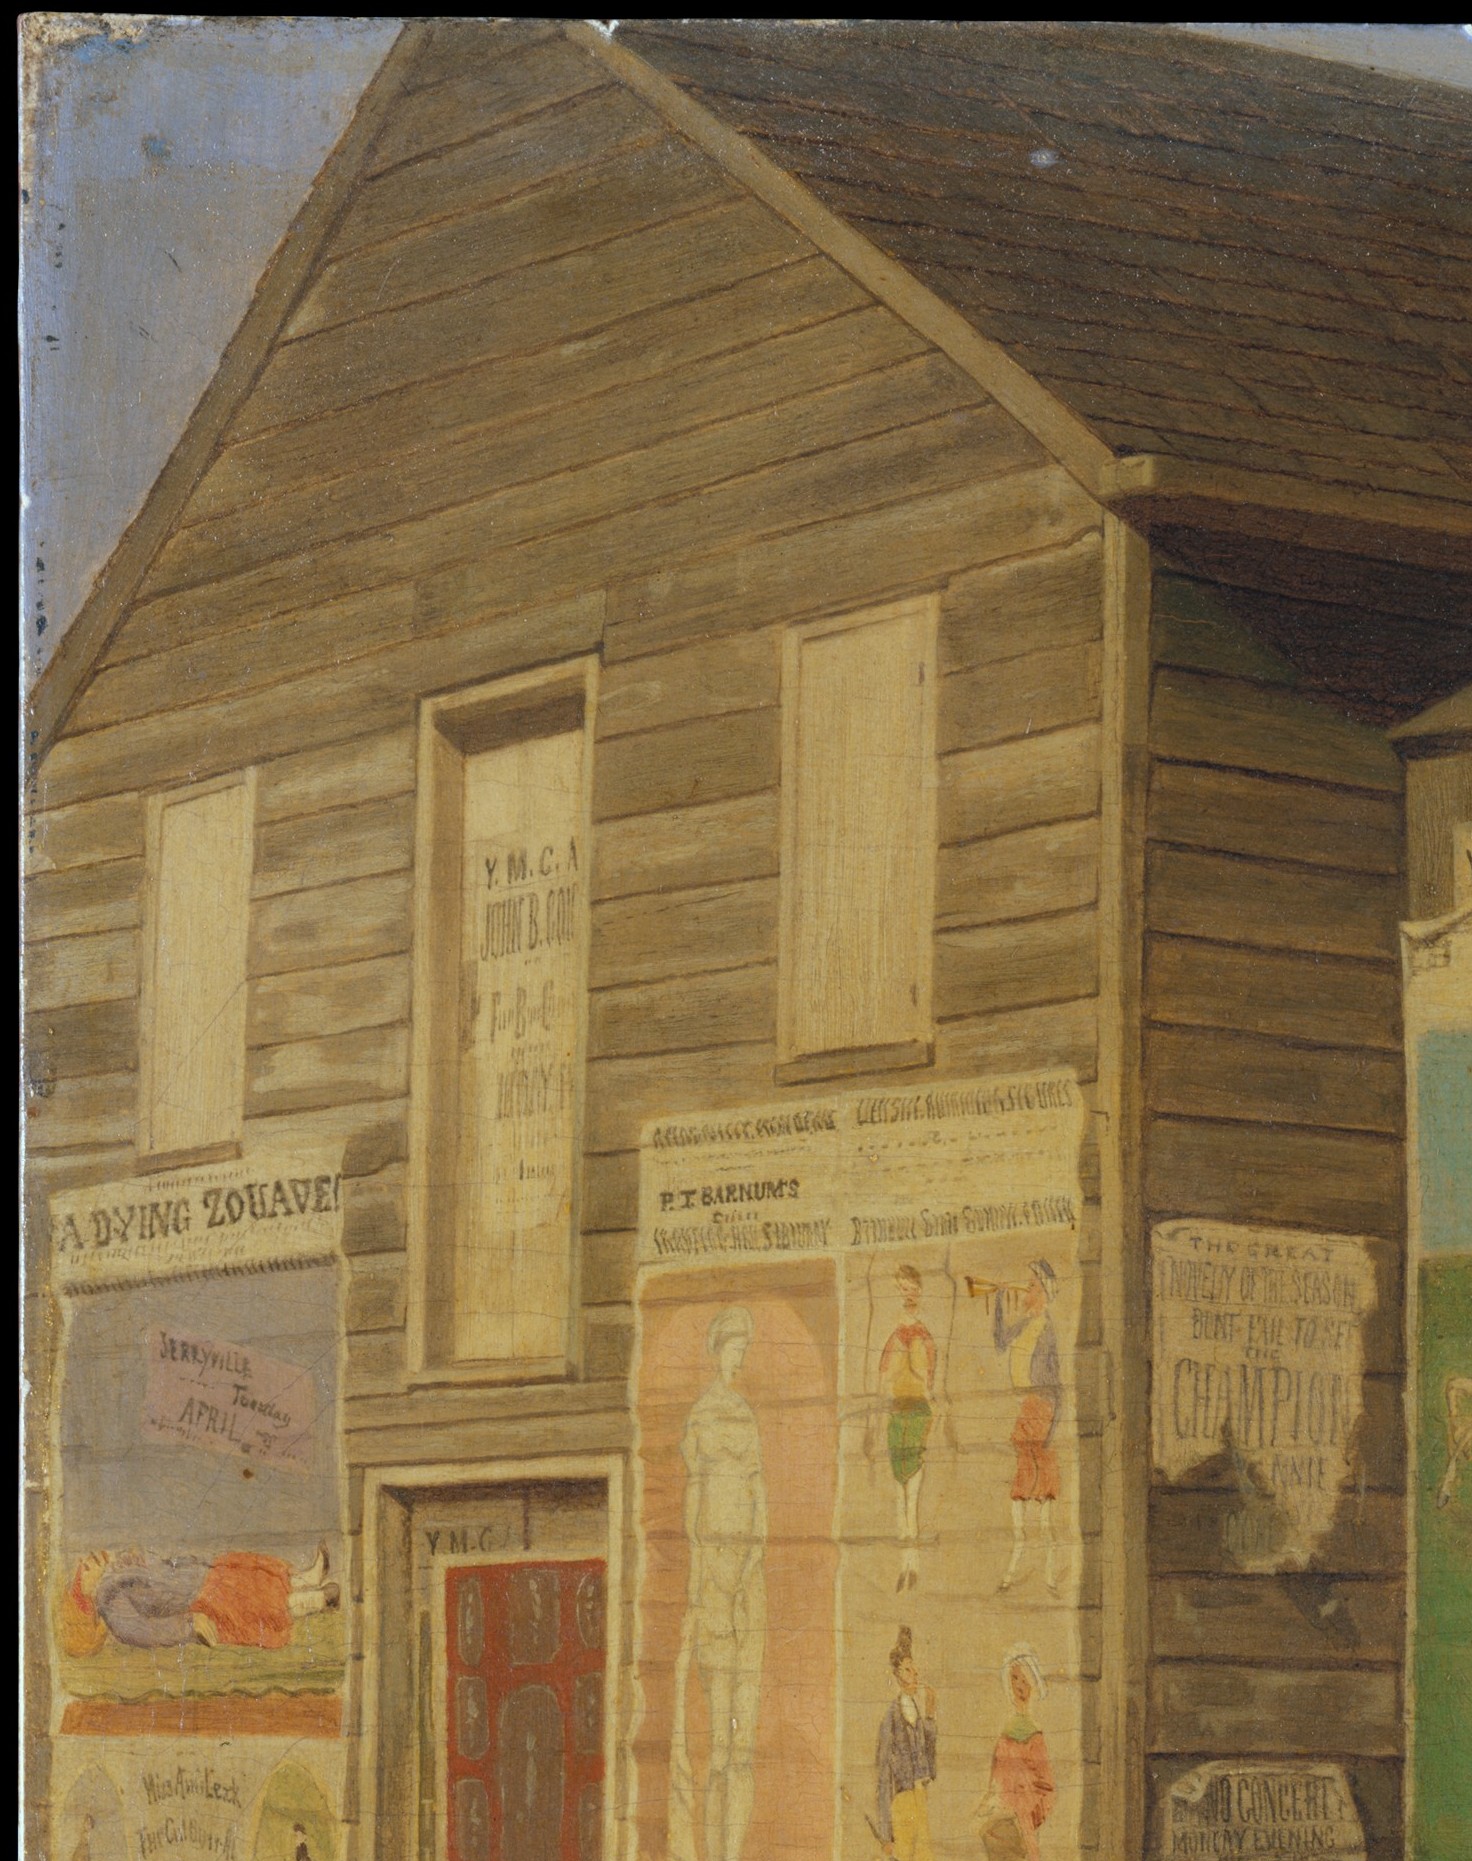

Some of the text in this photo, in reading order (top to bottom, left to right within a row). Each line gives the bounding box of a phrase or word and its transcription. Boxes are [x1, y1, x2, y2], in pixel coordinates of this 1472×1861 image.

[57, 1213, 85, 1251] A
[91, 1196, 193, 1249] DYING
[1252, 1825, 1336, 1852] EVENING
